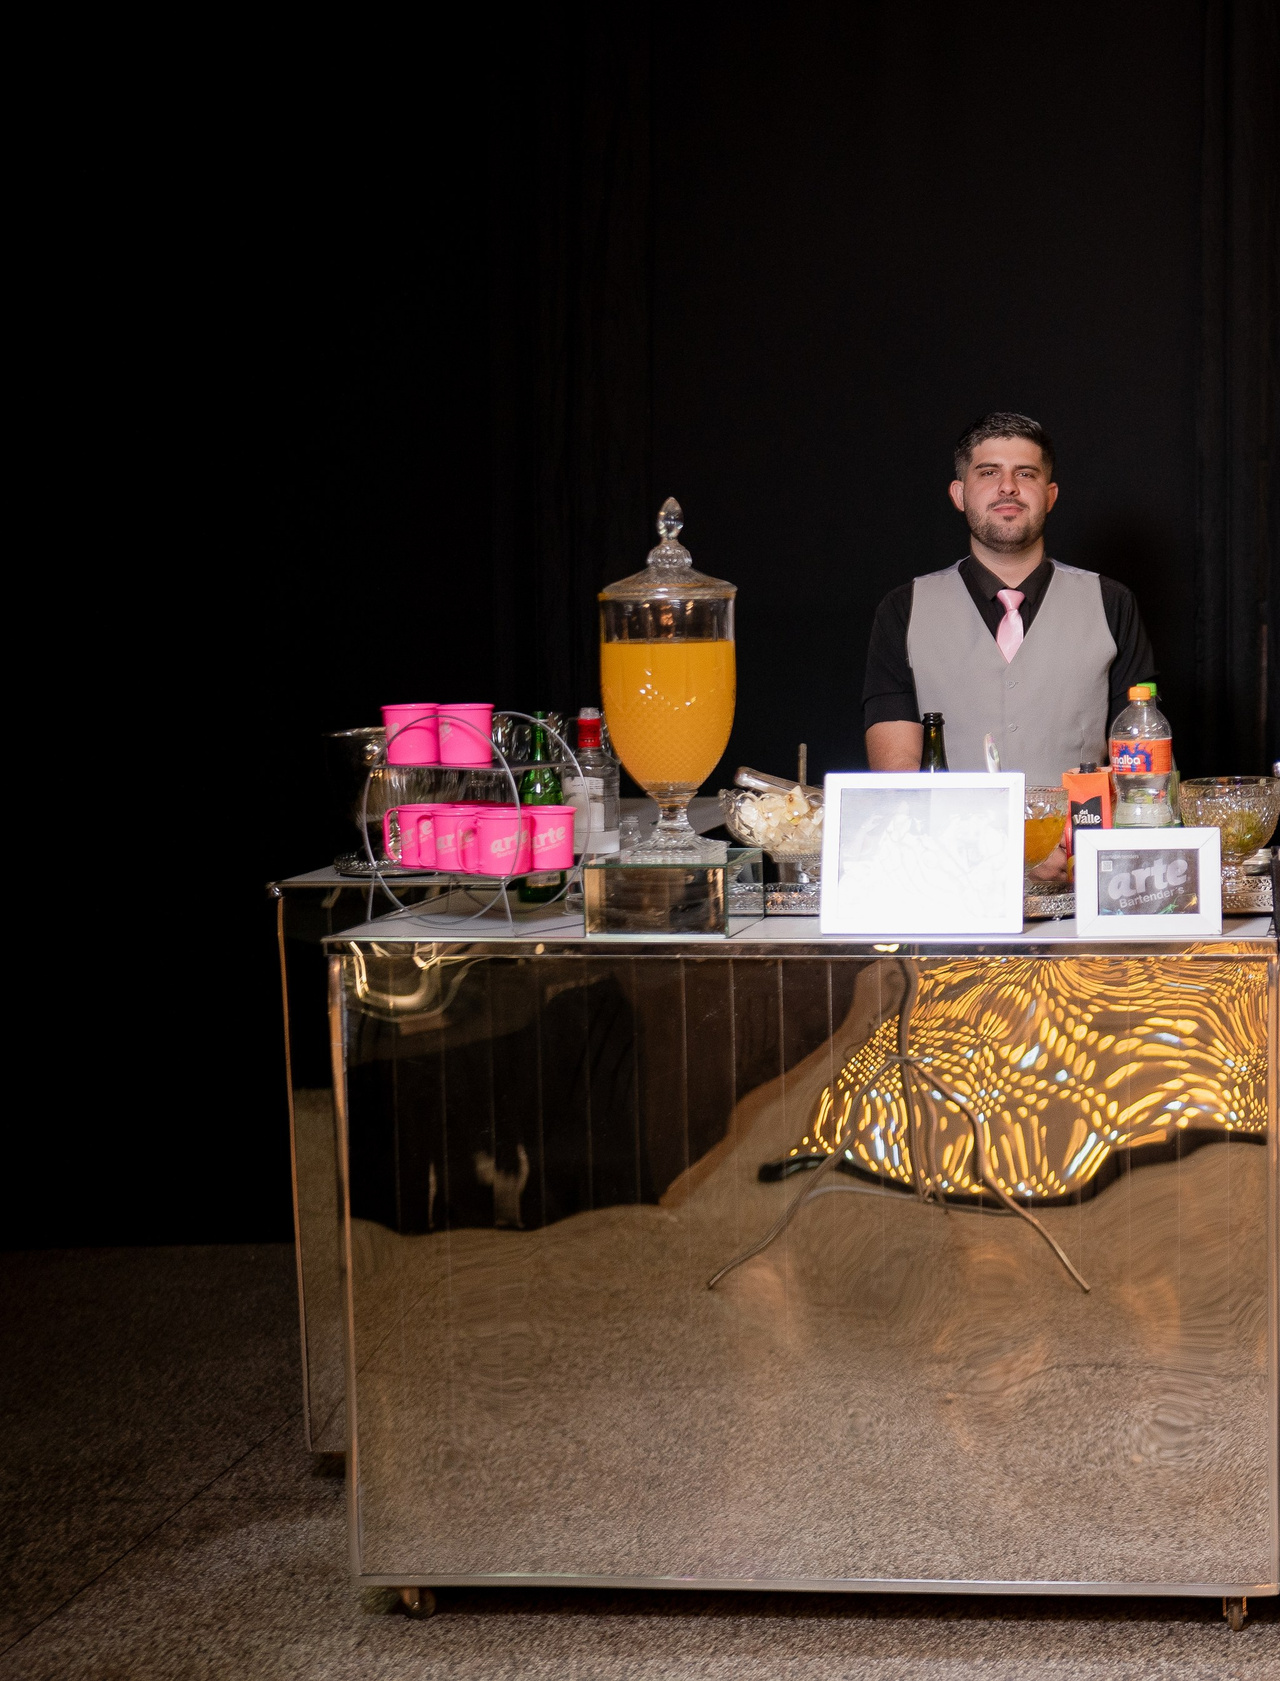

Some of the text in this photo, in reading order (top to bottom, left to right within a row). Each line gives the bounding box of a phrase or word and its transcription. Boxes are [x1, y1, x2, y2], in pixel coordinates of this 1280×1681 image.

[1073, 814, 1101, 824] Valle
[1108, 858, 1188, 900] arte
[1120, 886, 1185, 909] Bartender's
